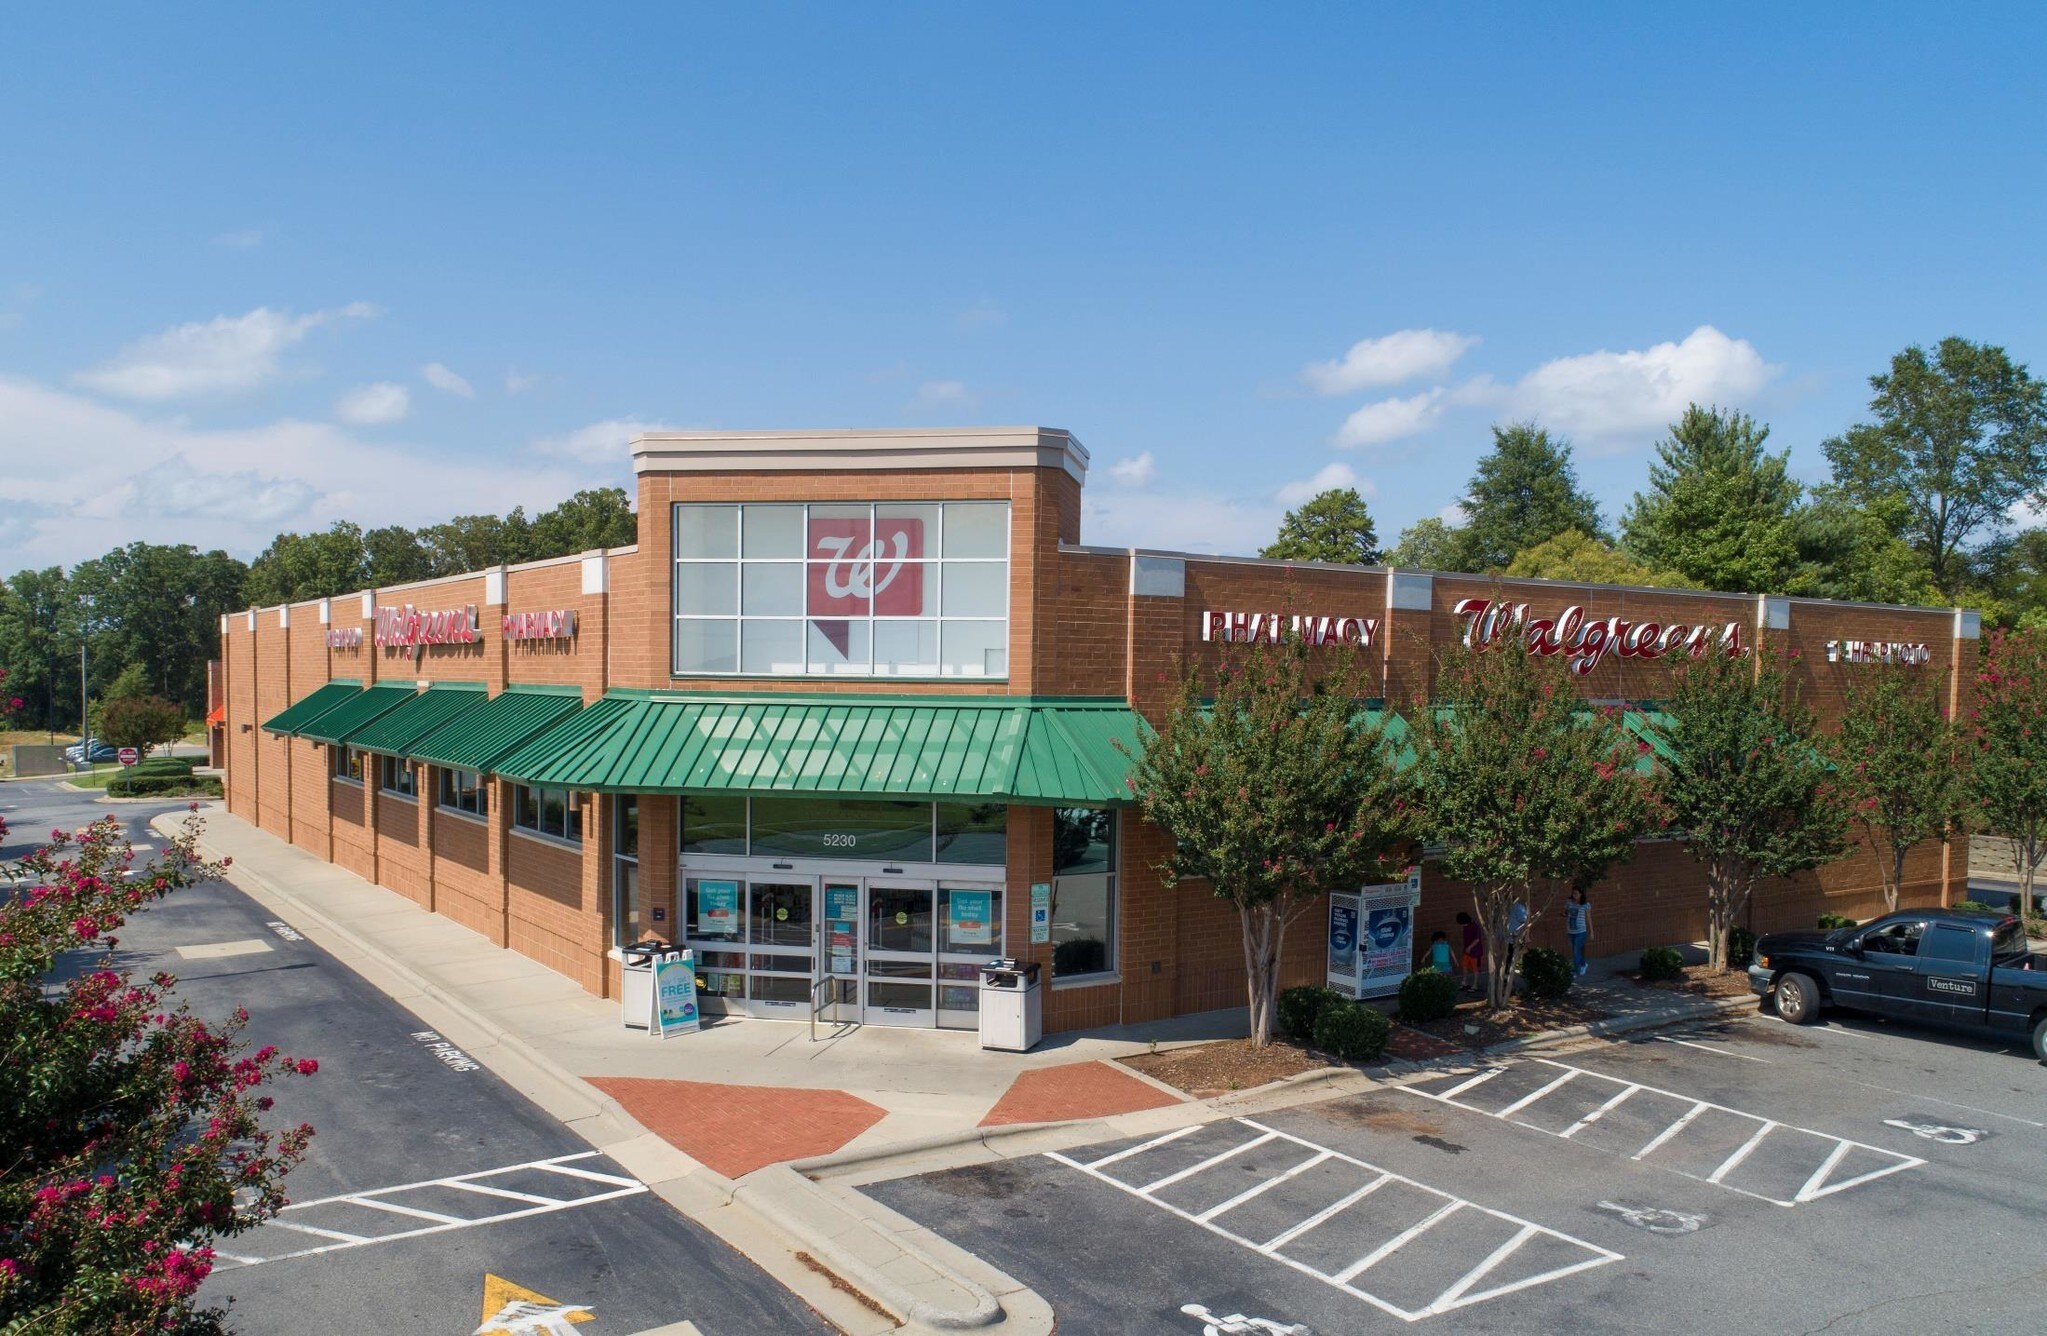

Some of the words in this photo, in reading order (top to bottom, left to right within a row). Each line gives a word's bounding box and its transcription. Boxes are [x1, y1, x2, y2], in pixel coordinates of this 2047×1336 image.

[817, 531, 909, 599] W
[823, 833, 857, 847] 5230
[661, 982, 692, 997] FREE
[1930, 979, 1973, 993] Venture
[424, 1042, 480, 1072] PARKING
